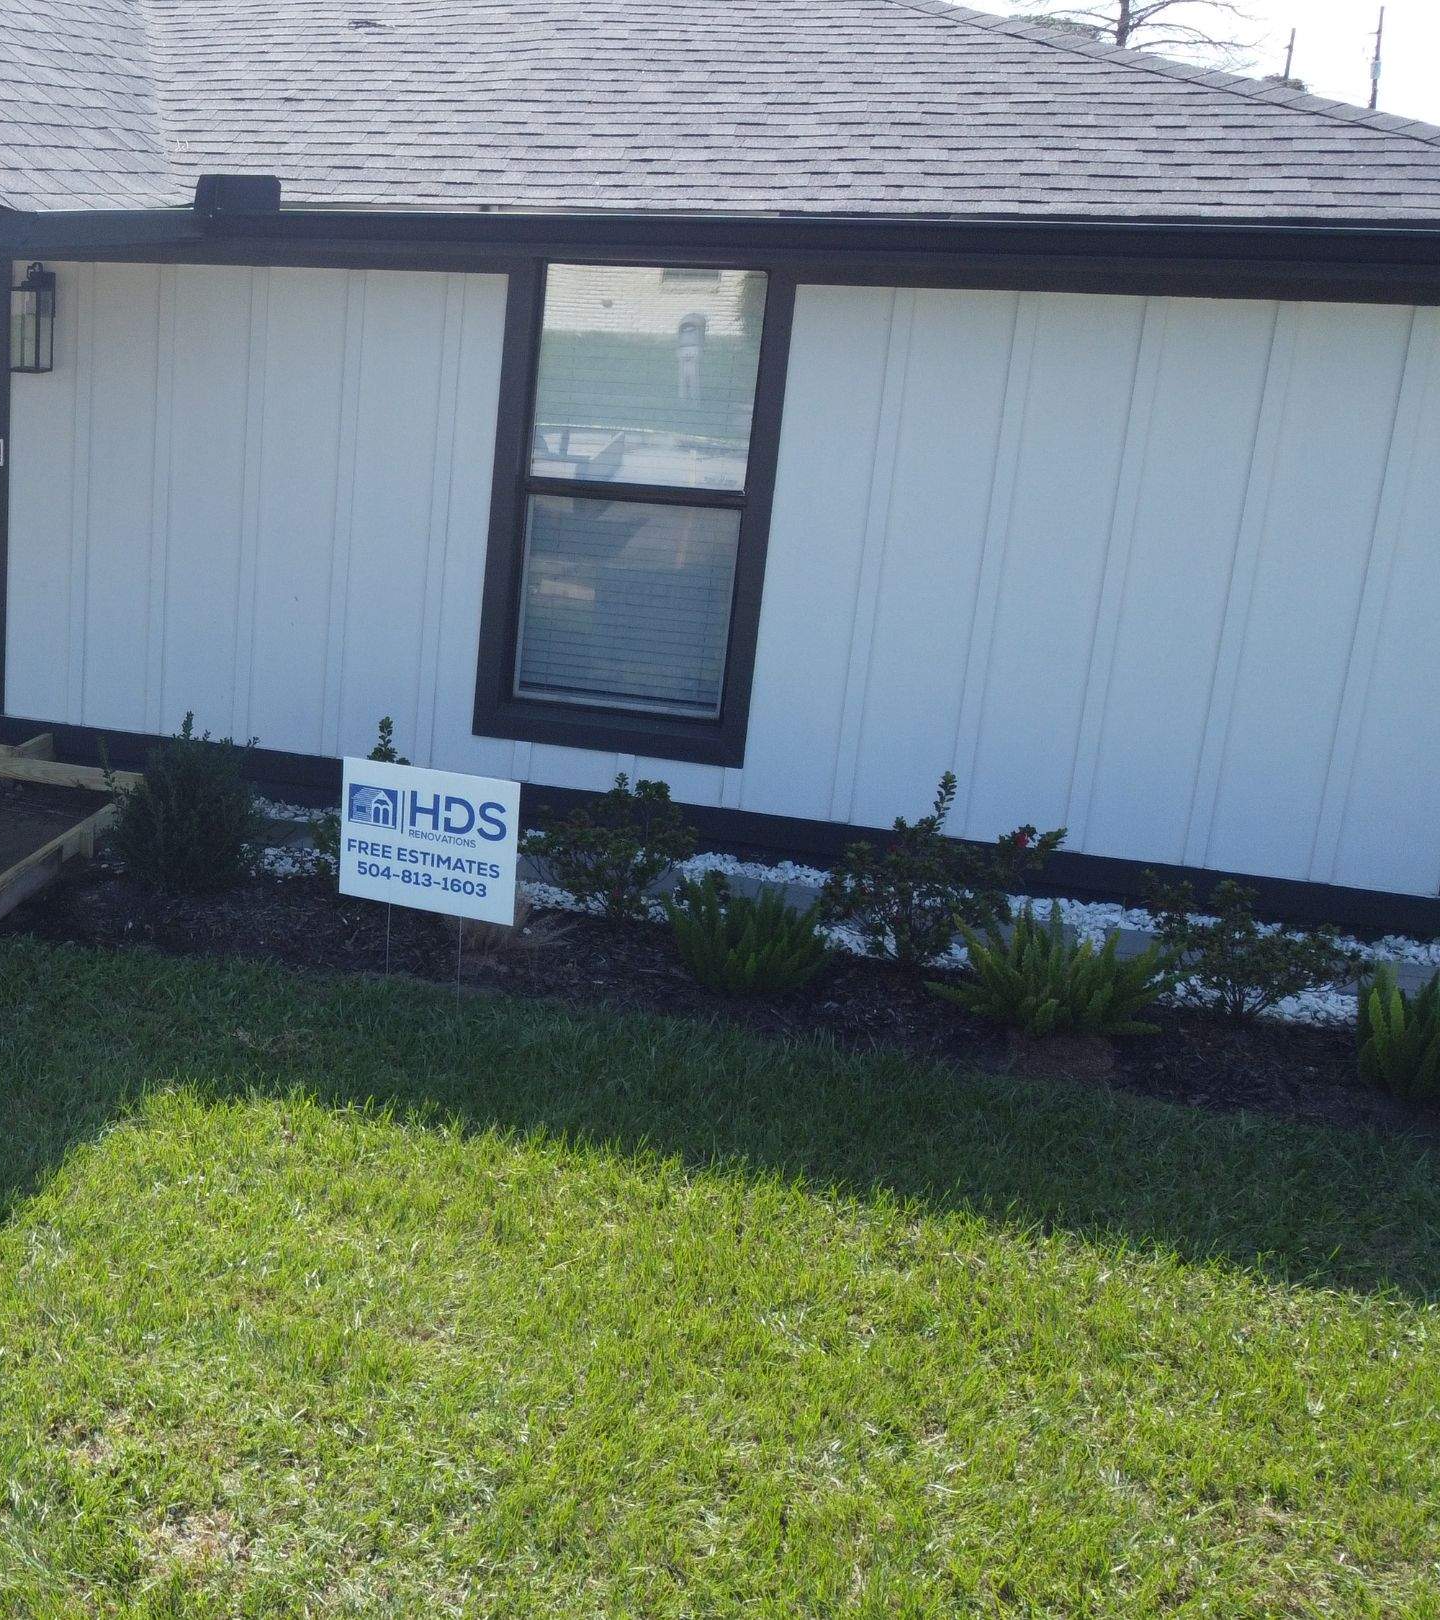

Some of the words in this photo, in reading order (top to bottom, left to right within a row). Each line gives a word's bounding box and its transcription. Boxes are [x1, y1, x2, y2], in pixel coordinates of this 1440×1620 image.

[409, 790, 507, 842] HDS
[347, 838, 392, 860] FREE
[396, 847, 500, 879] ESTIMATES
[408, 829, 477, 849] RENOVATIONS
[357, 860, 487, 898] 504-813-1603
